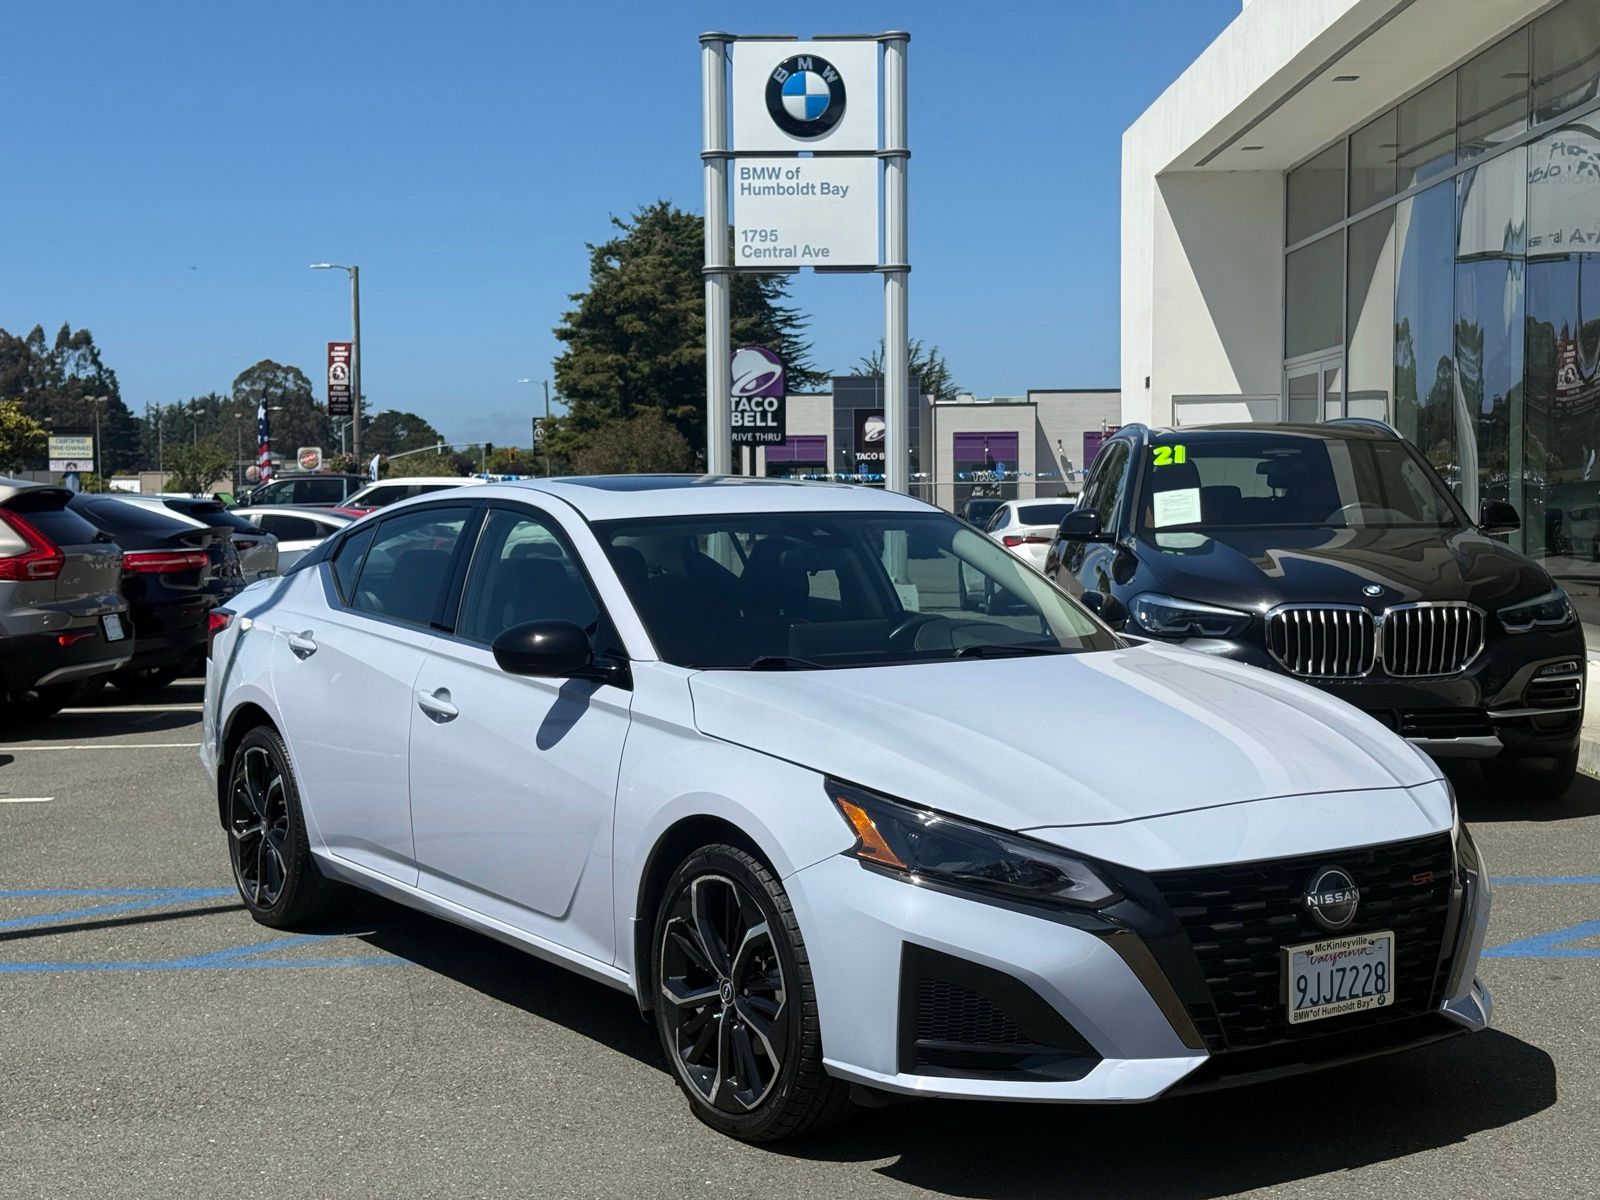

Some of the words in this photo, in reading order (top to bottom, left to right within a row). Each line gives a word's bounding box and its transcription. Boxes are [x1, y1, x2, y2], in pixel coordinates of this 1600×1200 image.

[772, 57, 839, 84] BMW
[740, 167, 782, 180] BMW
[785, 167, 801, 180] of
[740, 182, 816, 196] Humboldt
[819, 182, 849, 199] Bay
[741, 230, 778, 243] 1795
[741, 244, 797, 258] Central
[801, 245, 830, 258] Ave
[730, 397, 778, 412] TACO
[731, 412, 778, 427] BELL
[731, 432, 753, 442] RIVE
[755, 432, 782, 442] THRU
[855, 452, 878, 461] TACO
[1153, 444, 1186, 466] 21
[1307, 889, 1360, 906] NISSAN
[1314, 937, 1368, 953] McKinleyville
[1296, 961, 1386, 1009] 9JJZ228
[1312, 1008, 1320, 1018] of
[1322, 1002, 1356, 1015] Humboldt
